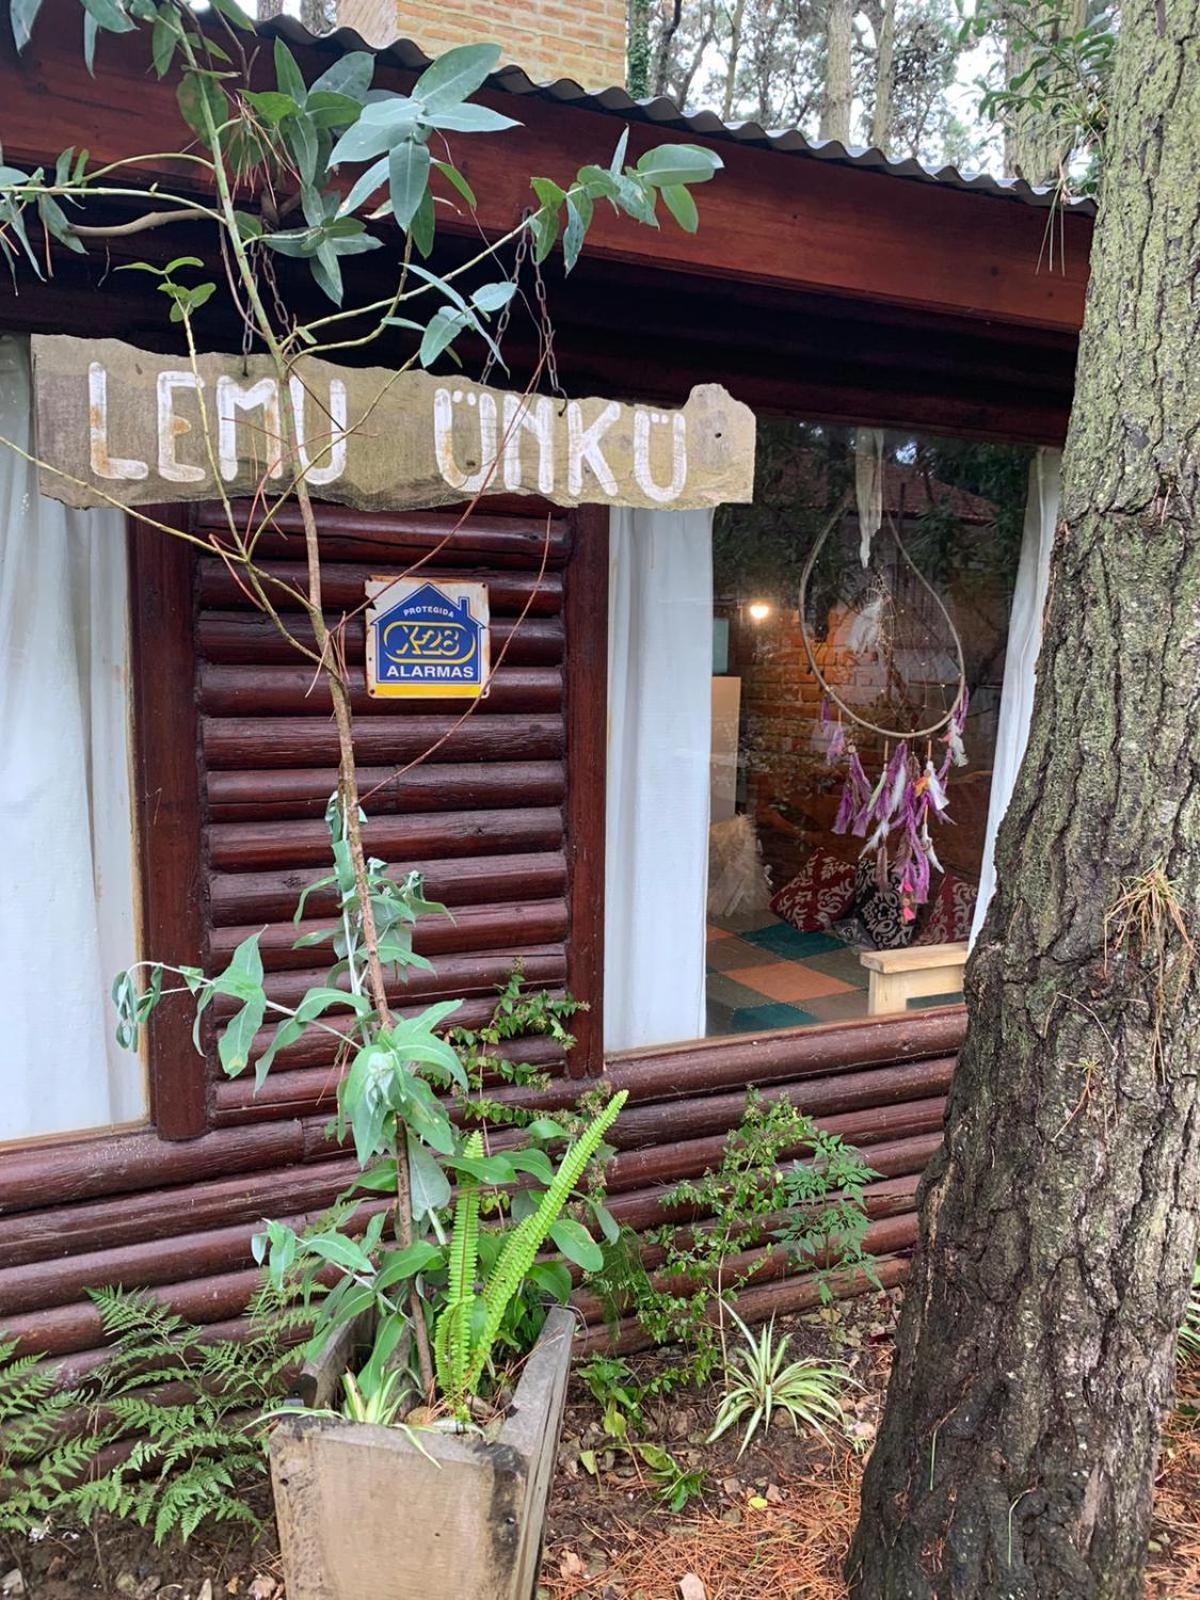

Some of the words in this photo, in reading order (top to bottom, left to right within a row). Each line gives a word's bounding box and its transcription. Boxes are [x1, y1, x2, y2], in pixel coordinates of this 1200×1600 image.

[88, 361, 347, 485] LEMU
[434, 388, 687, 501] ÜNKÜ
[403, 605, 454, 618] PROTEGIDA
[386, 665, 474, 678] ALARMAS
